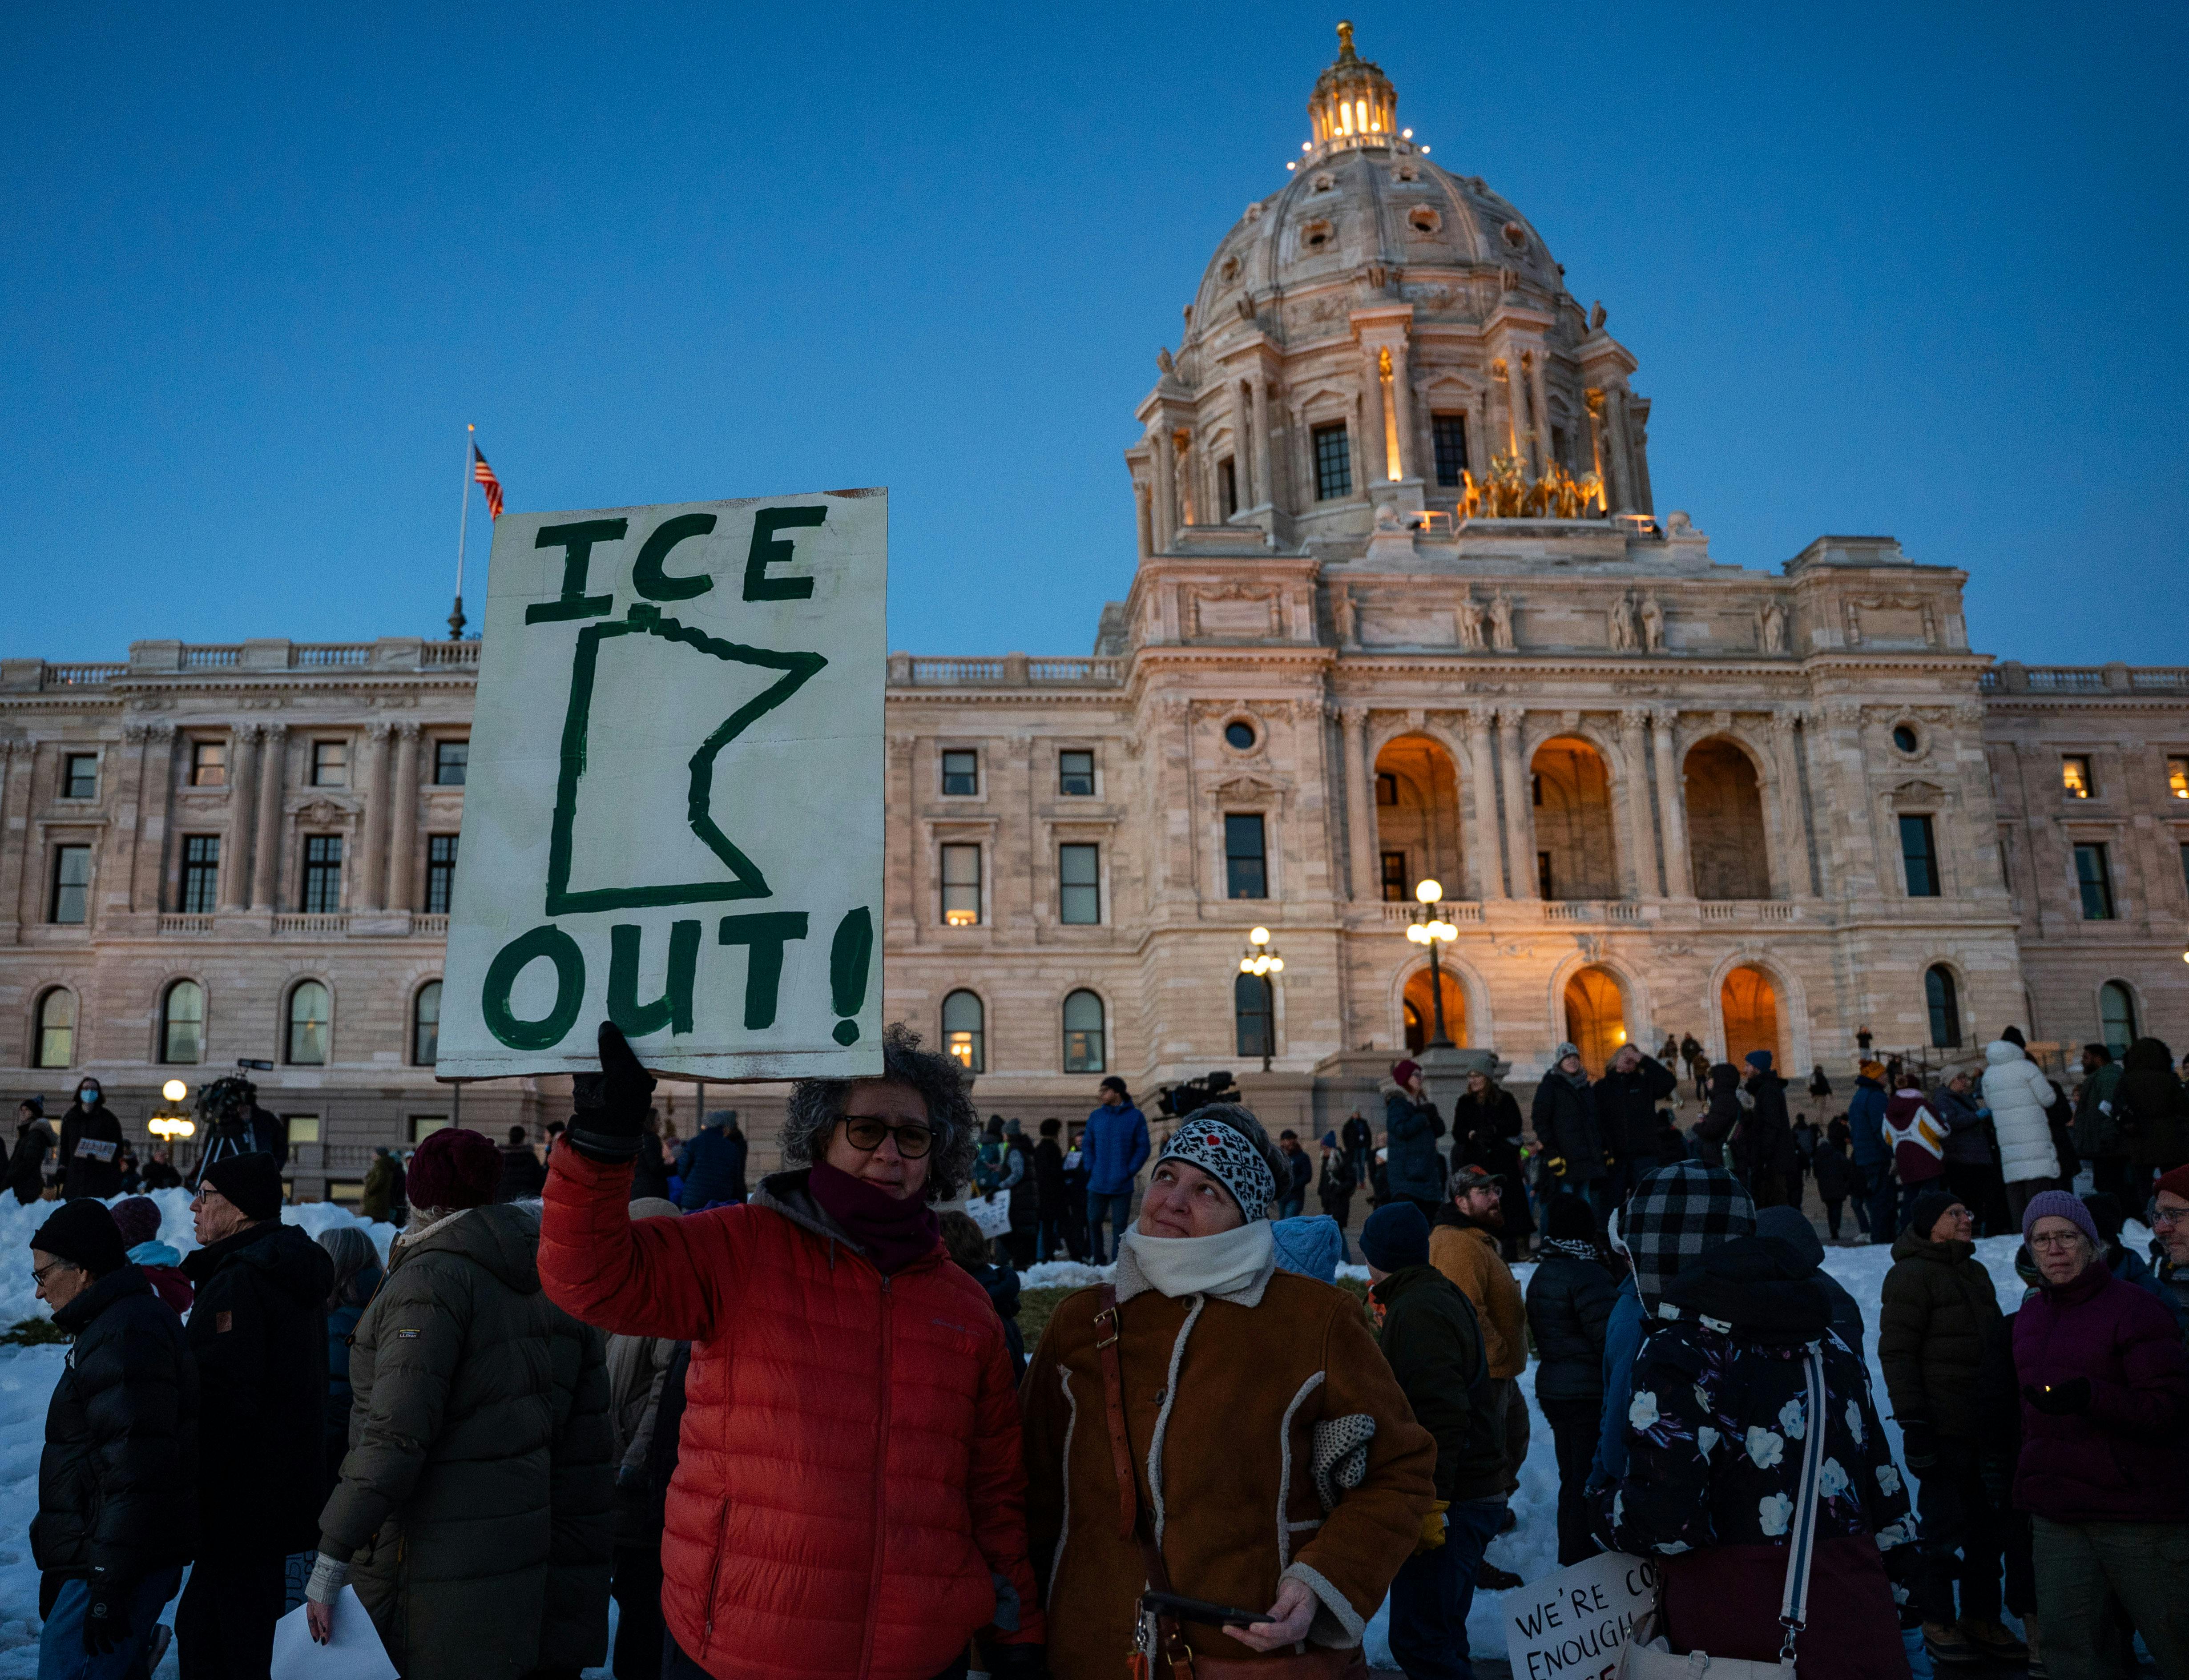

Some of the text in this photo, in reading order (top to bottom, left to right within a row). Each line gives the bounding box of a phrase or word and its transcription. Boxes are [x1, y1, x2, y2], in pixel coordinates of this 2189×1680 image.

[526, 506, 828, 625] ICE
[482, 906, 873, 1050] OUT!
[1516, 1562, 1654, 1639] WE'RE CO
[1527, 1612, 1633, 1680] ENOUGH
